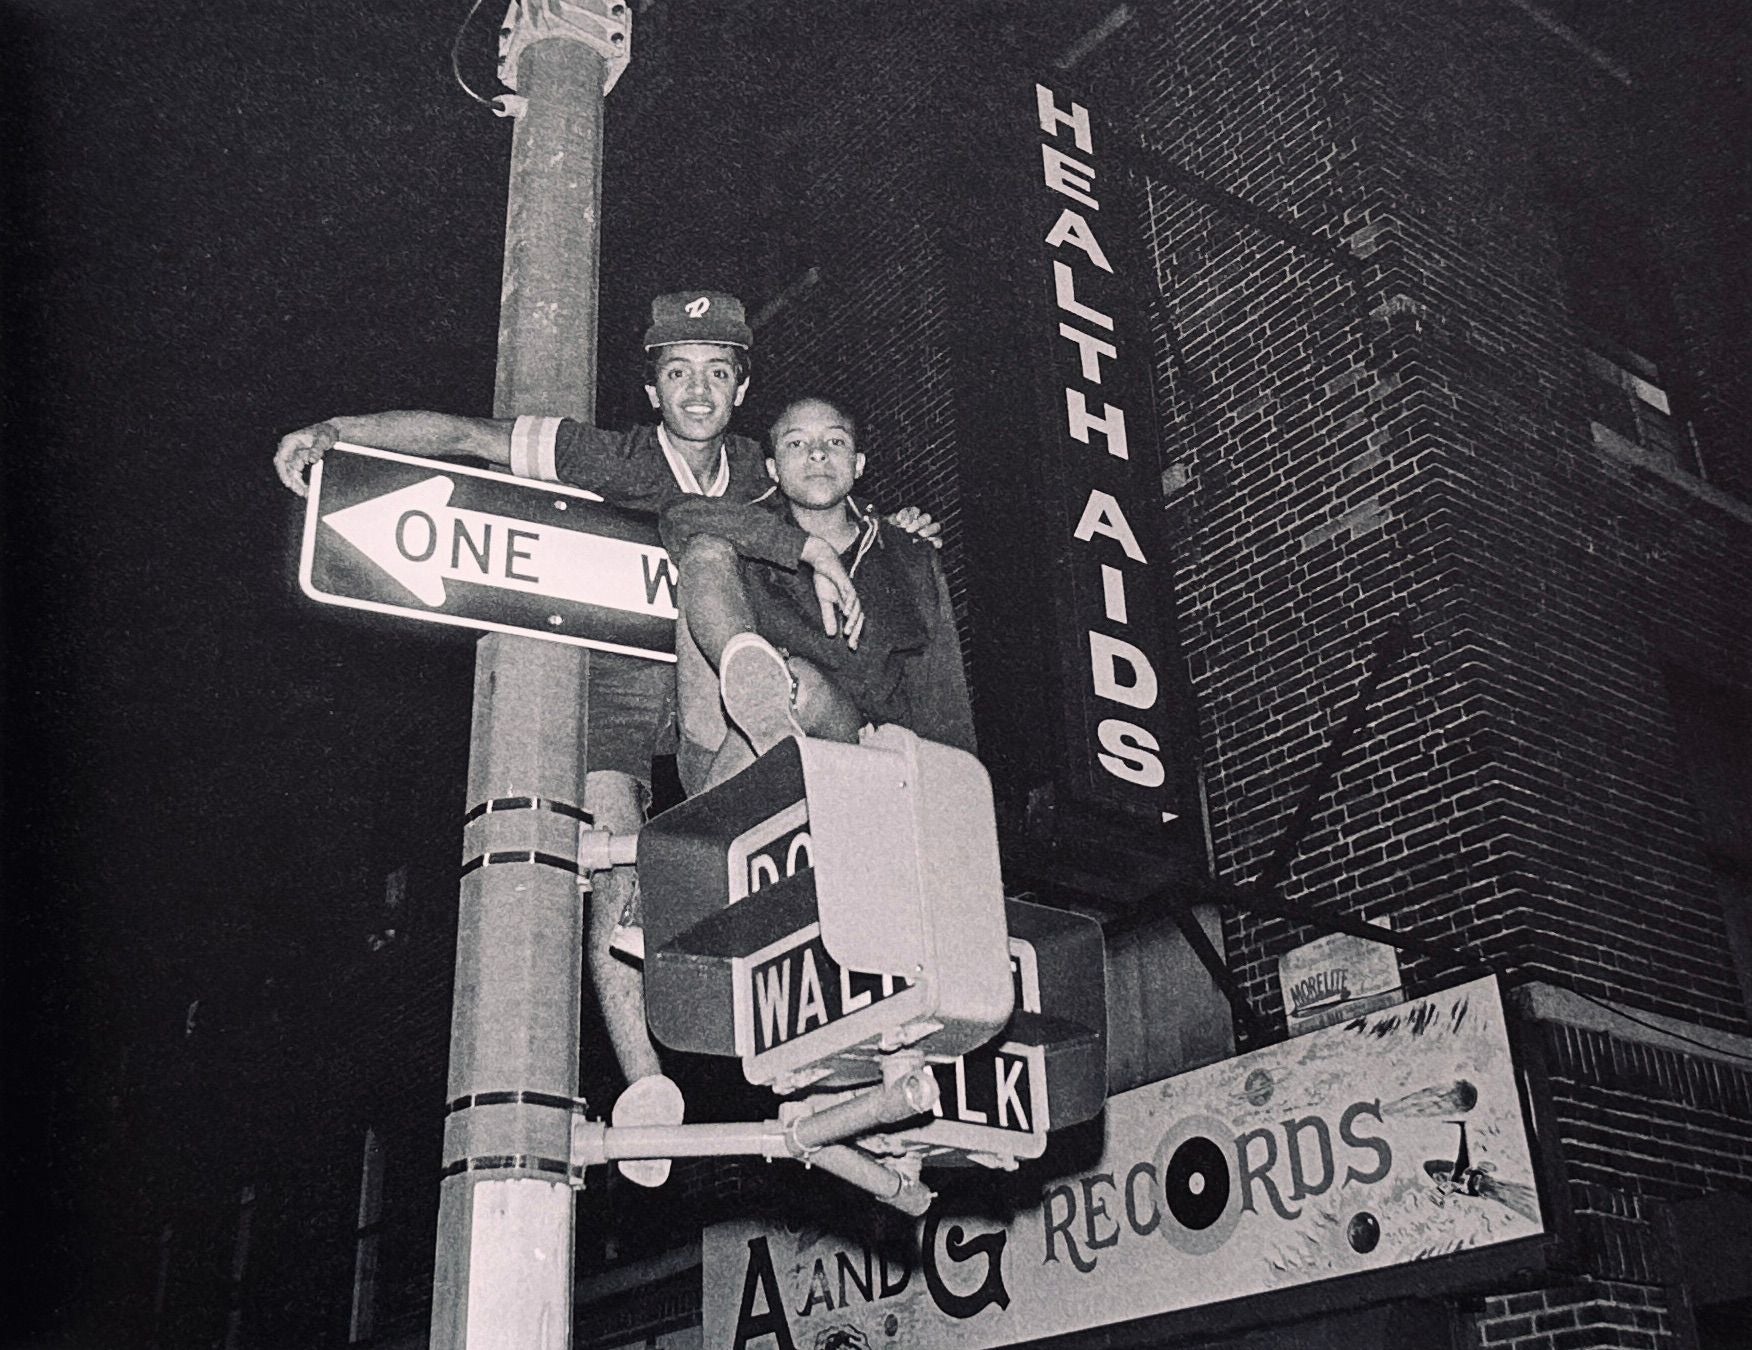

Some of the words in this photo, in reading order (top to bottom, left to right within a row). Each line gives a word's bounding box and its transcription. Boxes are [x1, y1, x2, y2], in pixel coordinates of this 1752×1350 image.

[1036, 83, 1129, 460] HEALTH
[395, 510, 540, 584] ONE
[1073, 488, 1166, 788] AIDS
[923, 1055, 1030, 1131] LK
[733, 1235, 798, 1350] A
[796, 1246, 913, 1317] AND
[922, 1203, 1011, 1320] G
[1042, 1098, 1393, 1274] RECORDS
